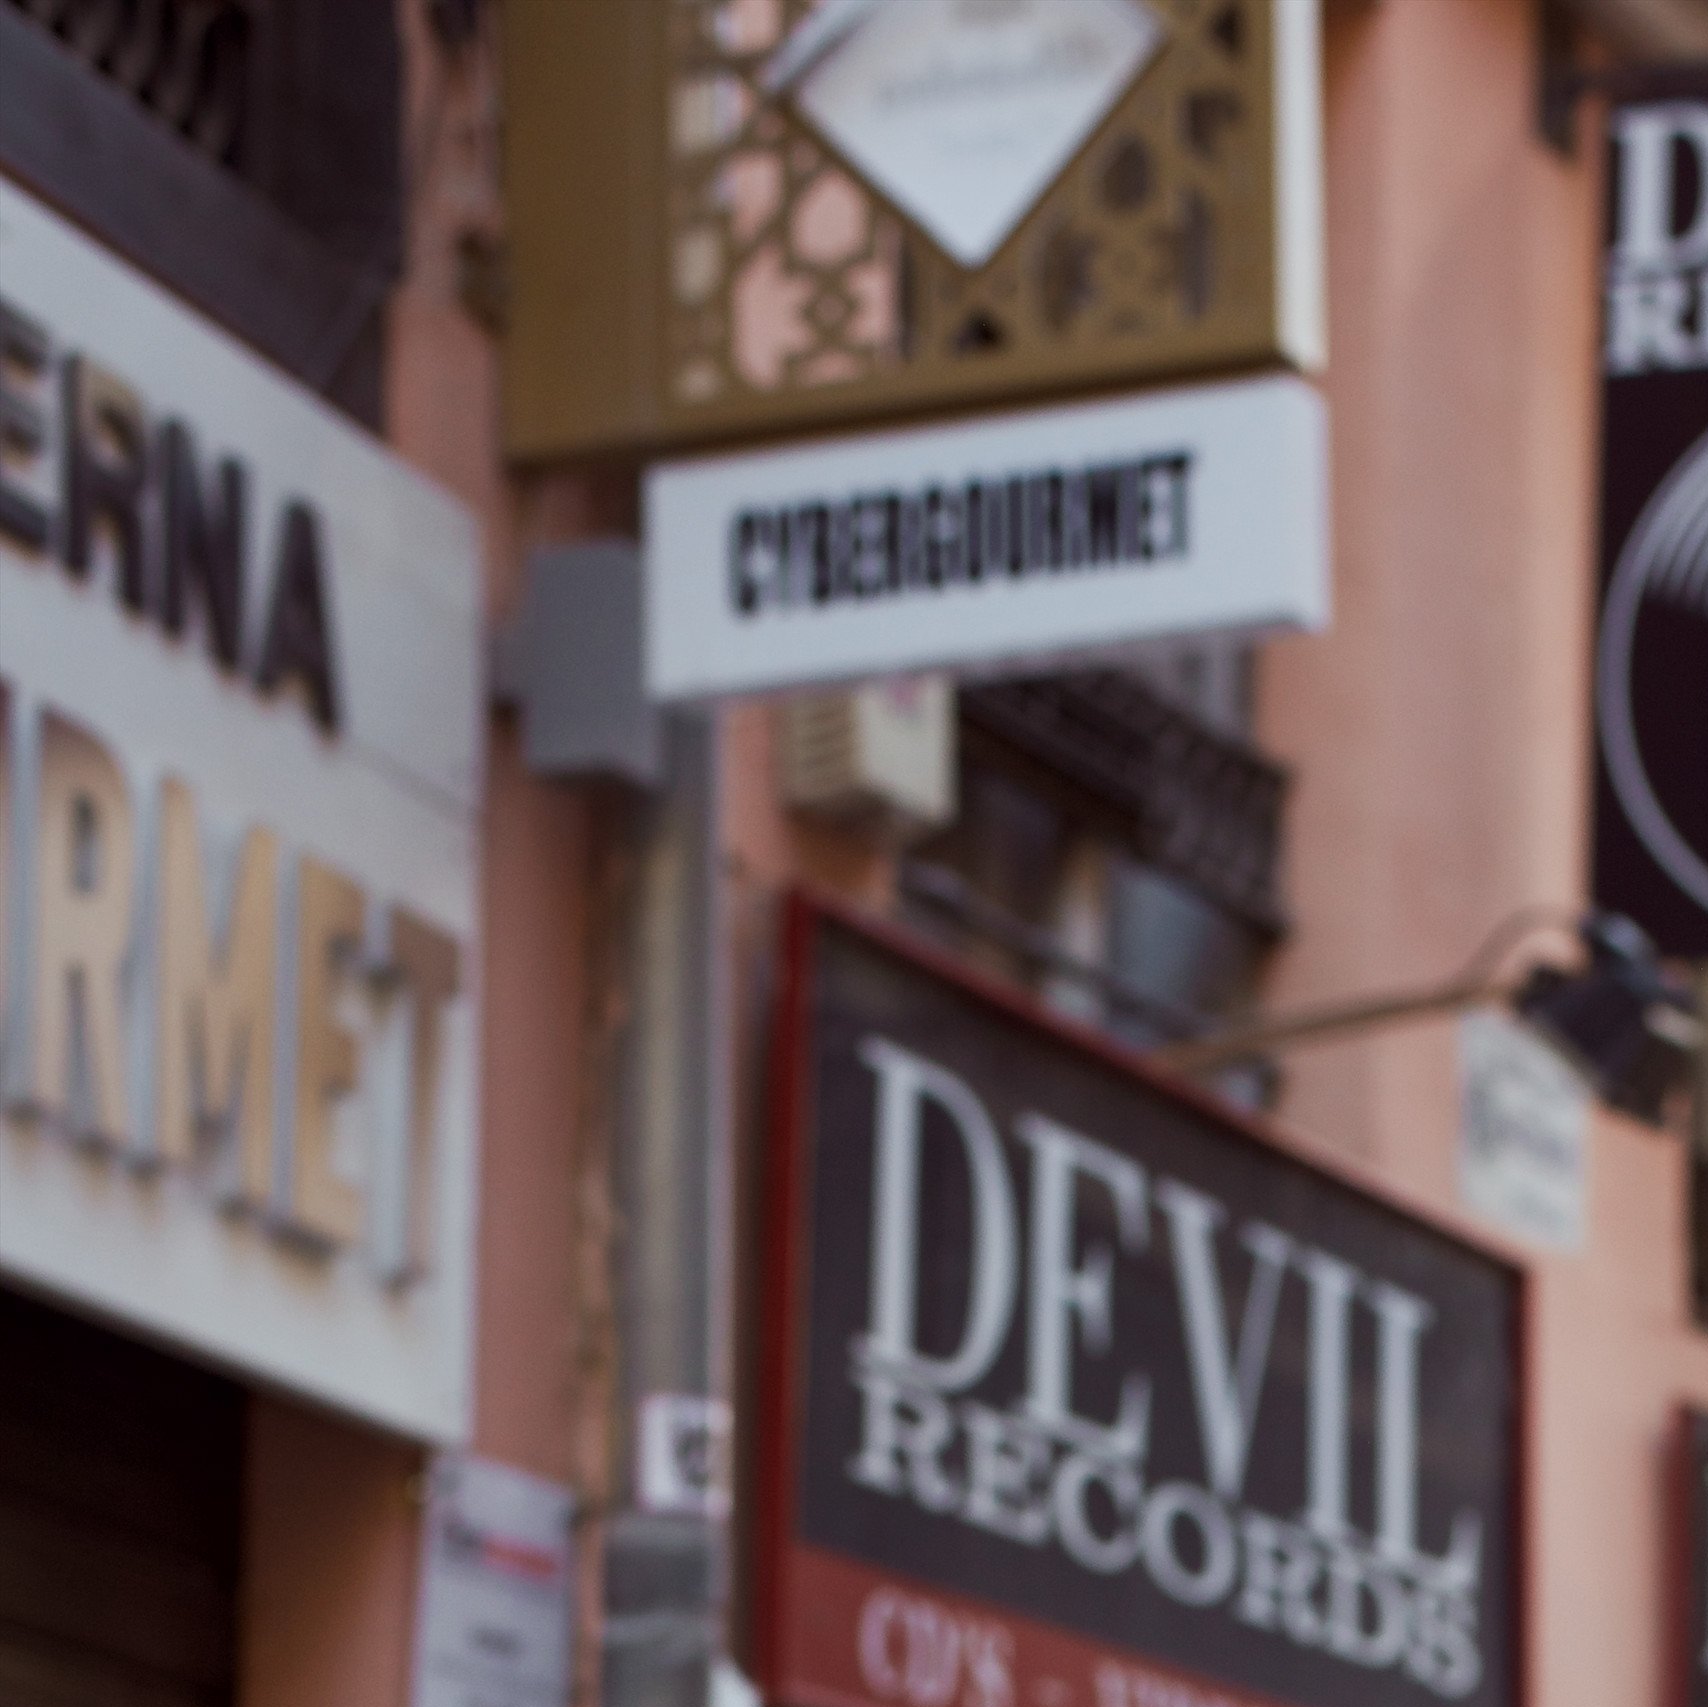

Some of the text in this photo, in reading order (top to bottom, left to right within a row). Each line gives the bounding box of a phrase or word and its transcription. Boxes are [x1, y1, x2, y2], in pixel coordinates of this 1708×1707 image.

[730, 446, 1194, 620] CYBERGOURMET
[855, 1034, 1484, 1594] DEVIL
[847, 1372, 1484, 1700] RECORDS
